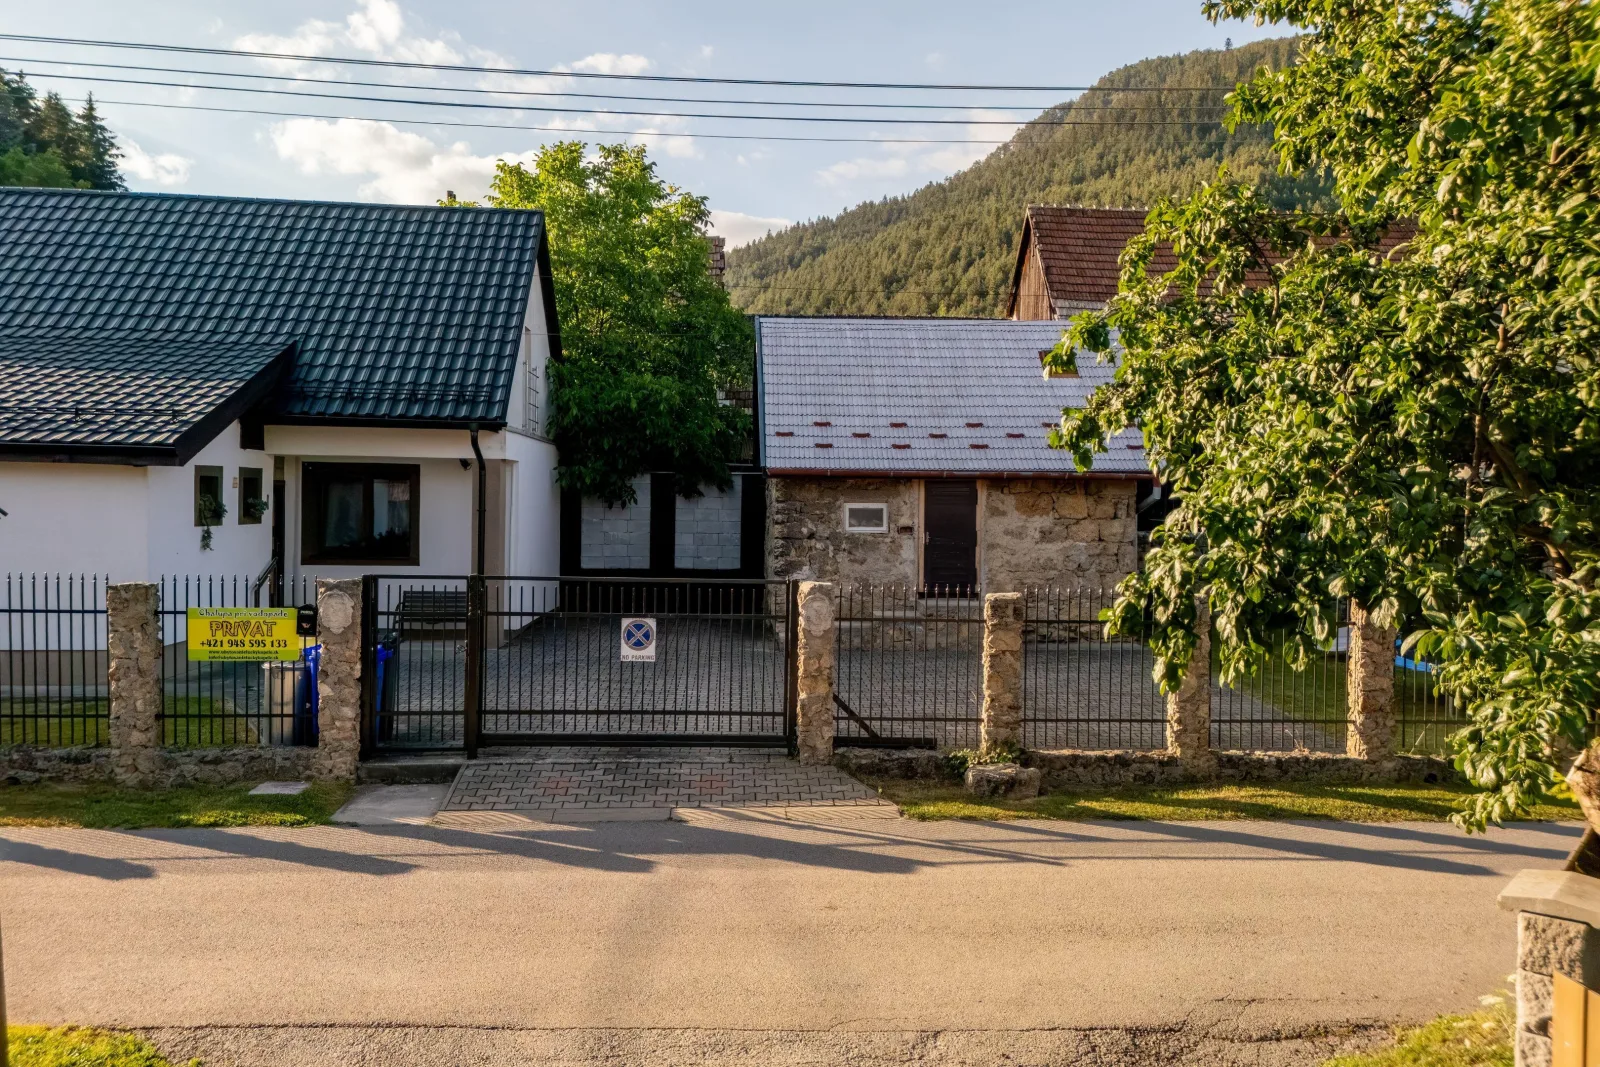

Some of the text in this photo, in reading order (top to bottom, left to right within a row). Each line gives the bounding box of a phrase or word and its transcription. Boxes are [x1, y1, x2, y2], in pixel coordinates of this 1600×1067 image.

[198, 608, 233, 618] Chalupa
[234, 609, 247, 618] pri
[209, 620, 277, 638] PRIVAT
[200, 638, 288, 648] +421 948 595 133
